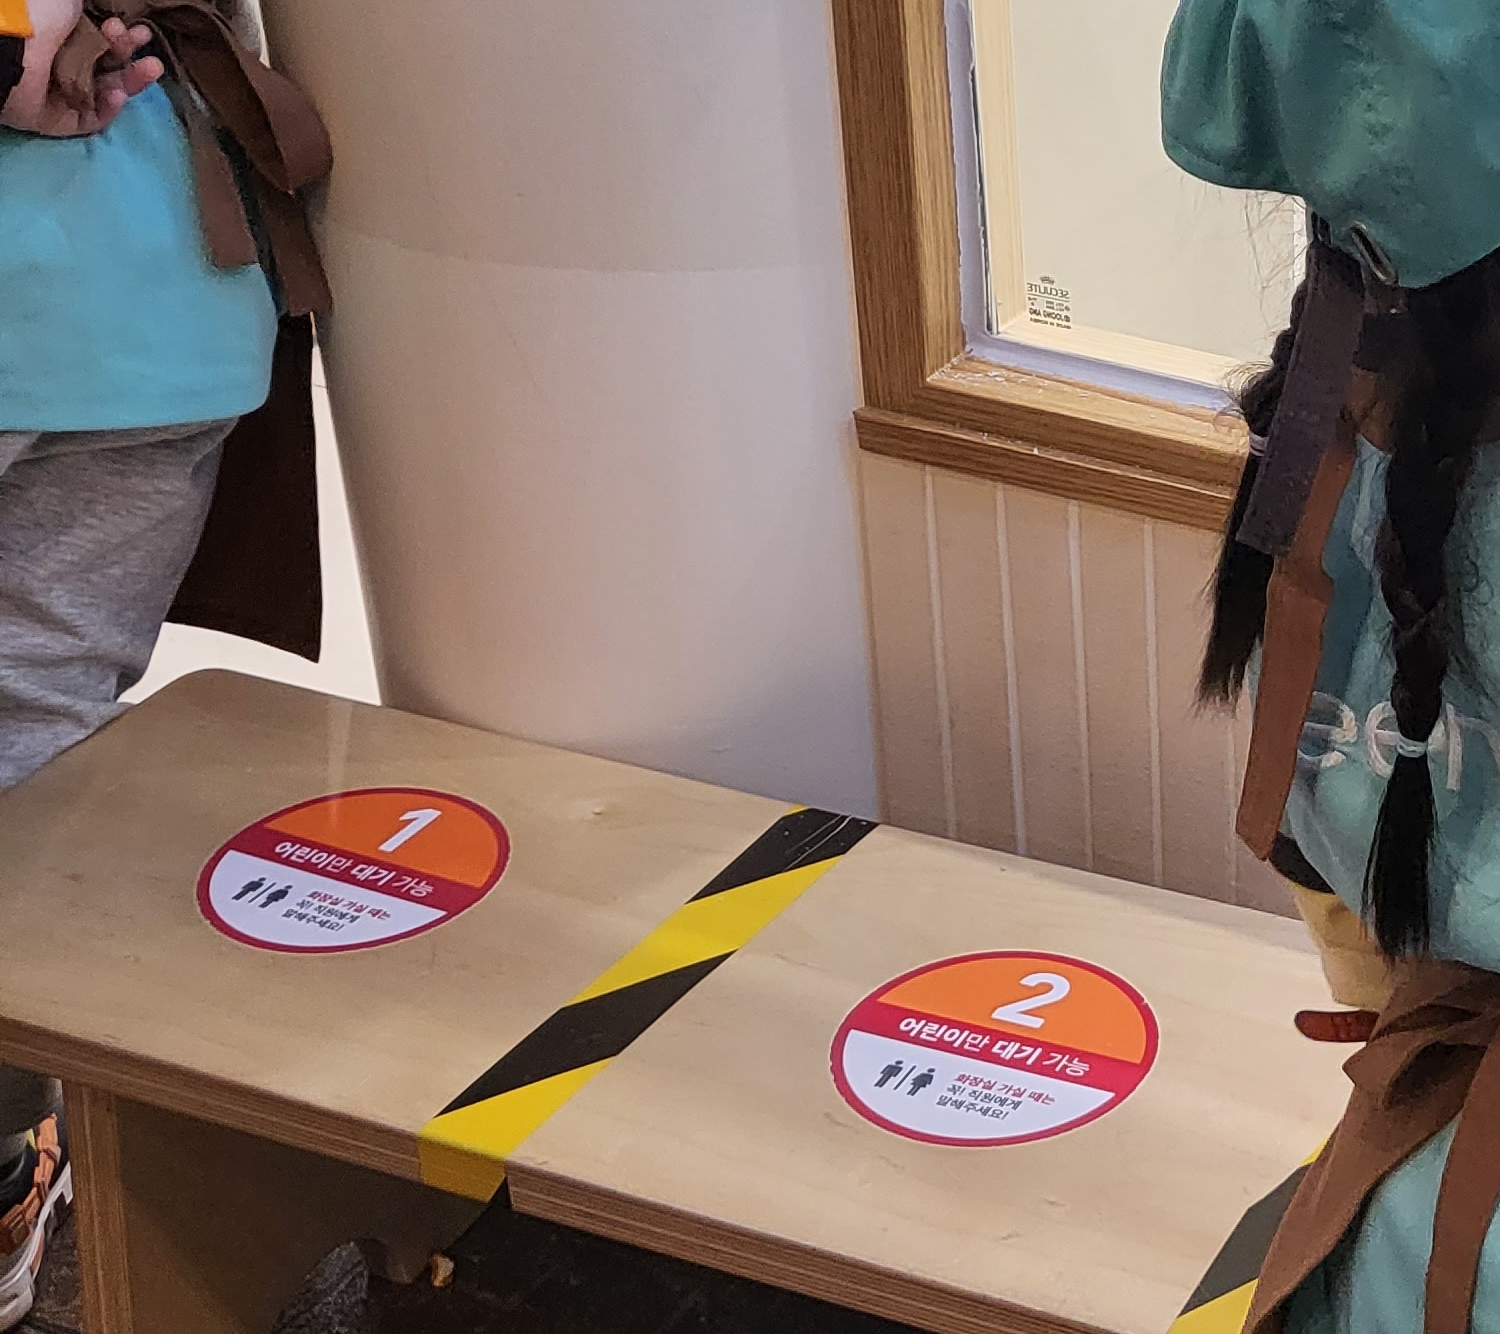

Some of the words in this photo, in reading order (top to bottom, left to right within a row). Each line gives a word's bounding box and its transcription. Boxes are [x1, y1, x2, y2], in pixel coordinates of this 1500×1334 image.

[378, 808, 442, 852] 1
[275, 842, 353, 873] 어린이만
[351, 864, 396, 886] 대기
[392, 875, 434, 897] 가능
[991, 972, 1070, 1029] 2
[899, 1017, 991, 1053] 어린이만
[991, 1040, 1043, 1065] 대기
[1042, 1052, 1090, 1076] 가능
[936, 1094, 1009, 1120] 말해주세요!
[954, 1073, 997, 1091] 화장실
[997, 1083, 1026, 1098] 가실
[1028, 1090, 1055, 1105] 때는
[968, 1089, 1022, 1110] 직원에게
